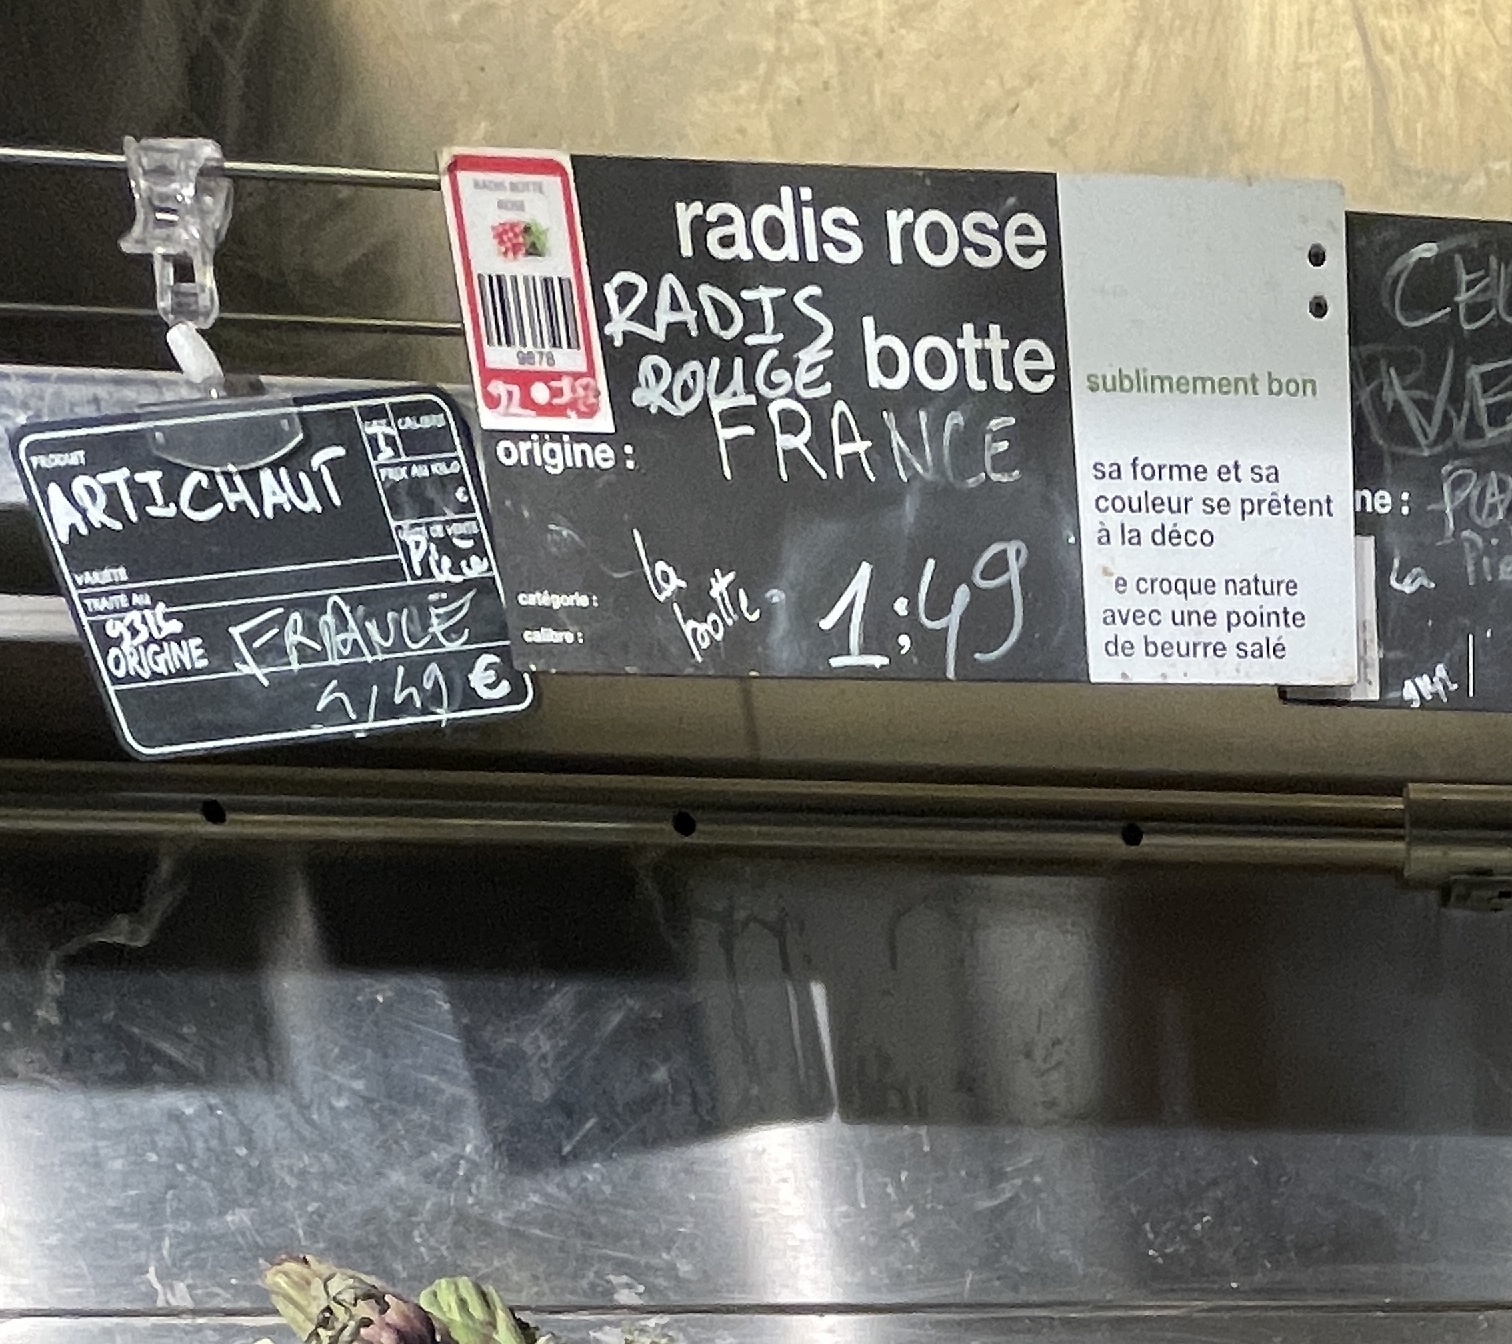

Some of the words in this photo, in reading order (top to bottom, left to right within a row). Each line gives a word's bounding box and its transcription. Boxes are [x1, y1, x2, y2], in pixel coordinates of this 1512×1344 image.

[675, 186, 864, 264] radis
[885, 207, 1048, 270] rose
[604, 270, 834, 360] RADIS
[862, 315, 1057, 394] botte
[632, 349, 833, 417] ROUGE
[1086, 367, 1260, 396] sublimement
[1267, 371, 1318, 397] bon
[710, 394, 1021, 489] FRANCE
[1092, 461, 1122, 481] sa
[1131, 456, 1208, 482] forme
[1216, 460, 1242, 483] et
[1250, 463, 1280, 484] sa
[47, 445, 347, 544] ARTICHAUT
[1094, 490, 1193, 514] couleur
[1201, 496, 1231, 515] se
[1240, 491, 1334, 521] prêtent
[1097, 521, 1112, 546] à
[1120, 522, 1141, 547] la
[1151, 522, 1215, 547] déco
[1135, 575, 1217, 601] croque
[1223, 573, 1298, 597] nature
[229, 587, 478, 687] FRANCE
[1102, 607, 1162, 626] avec
[1171, 608, 1217, 628] une
[1226, 605, 1306, 633] pointe
[106, 637, 210, 680] ORIGINE
[1104, 634, 1135, 657] de
[1143, 635, 1228, 659] beurre
[1235, 636, 1287, 660] salé
[468, 653, 512, 700] €
